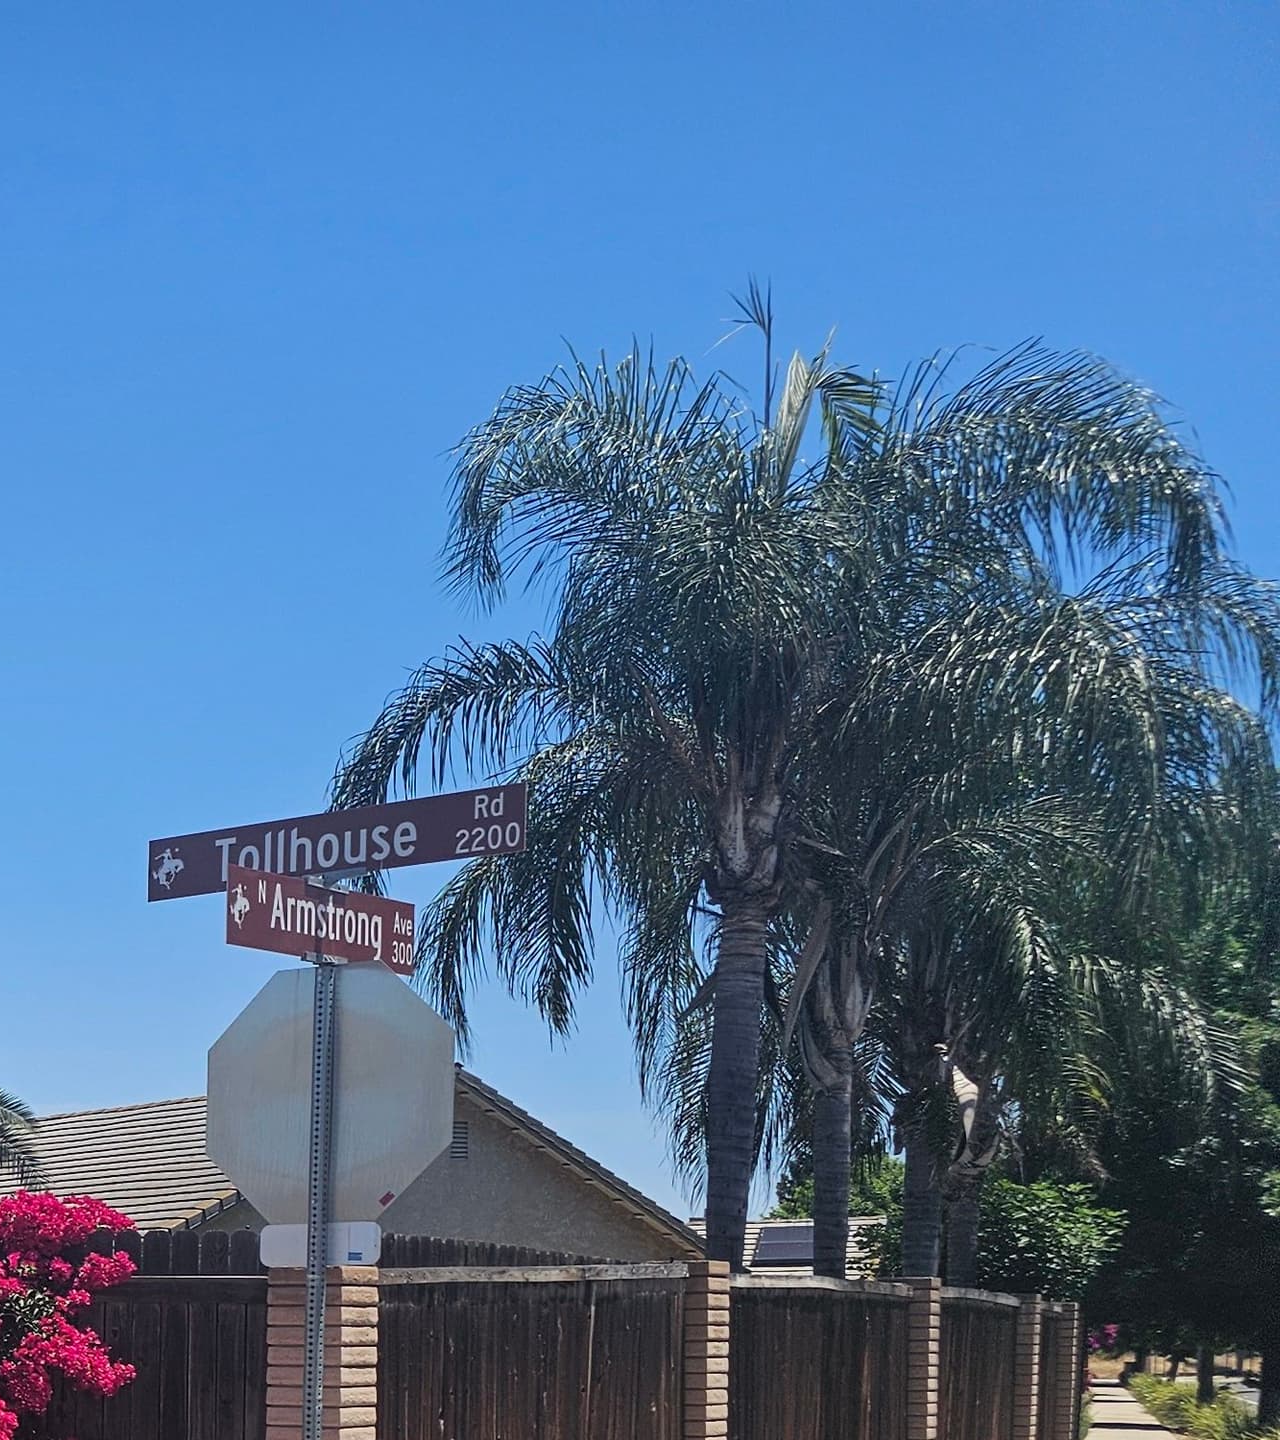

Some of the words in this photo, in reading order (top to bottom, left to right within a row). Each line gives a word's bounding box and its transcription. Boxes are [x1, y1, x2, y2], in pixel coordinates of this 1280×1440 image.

[215, 821, 418, 882] Tollhouse
[474, 792, 504, 819] Rd
[455, 822, 521, 854] 2200
[258, 880, 267, 904] N
[270, 883, 383, 960] Armstrong
[393, 911, 413, 936] Ave
[391, 940, 413, 965] 300
